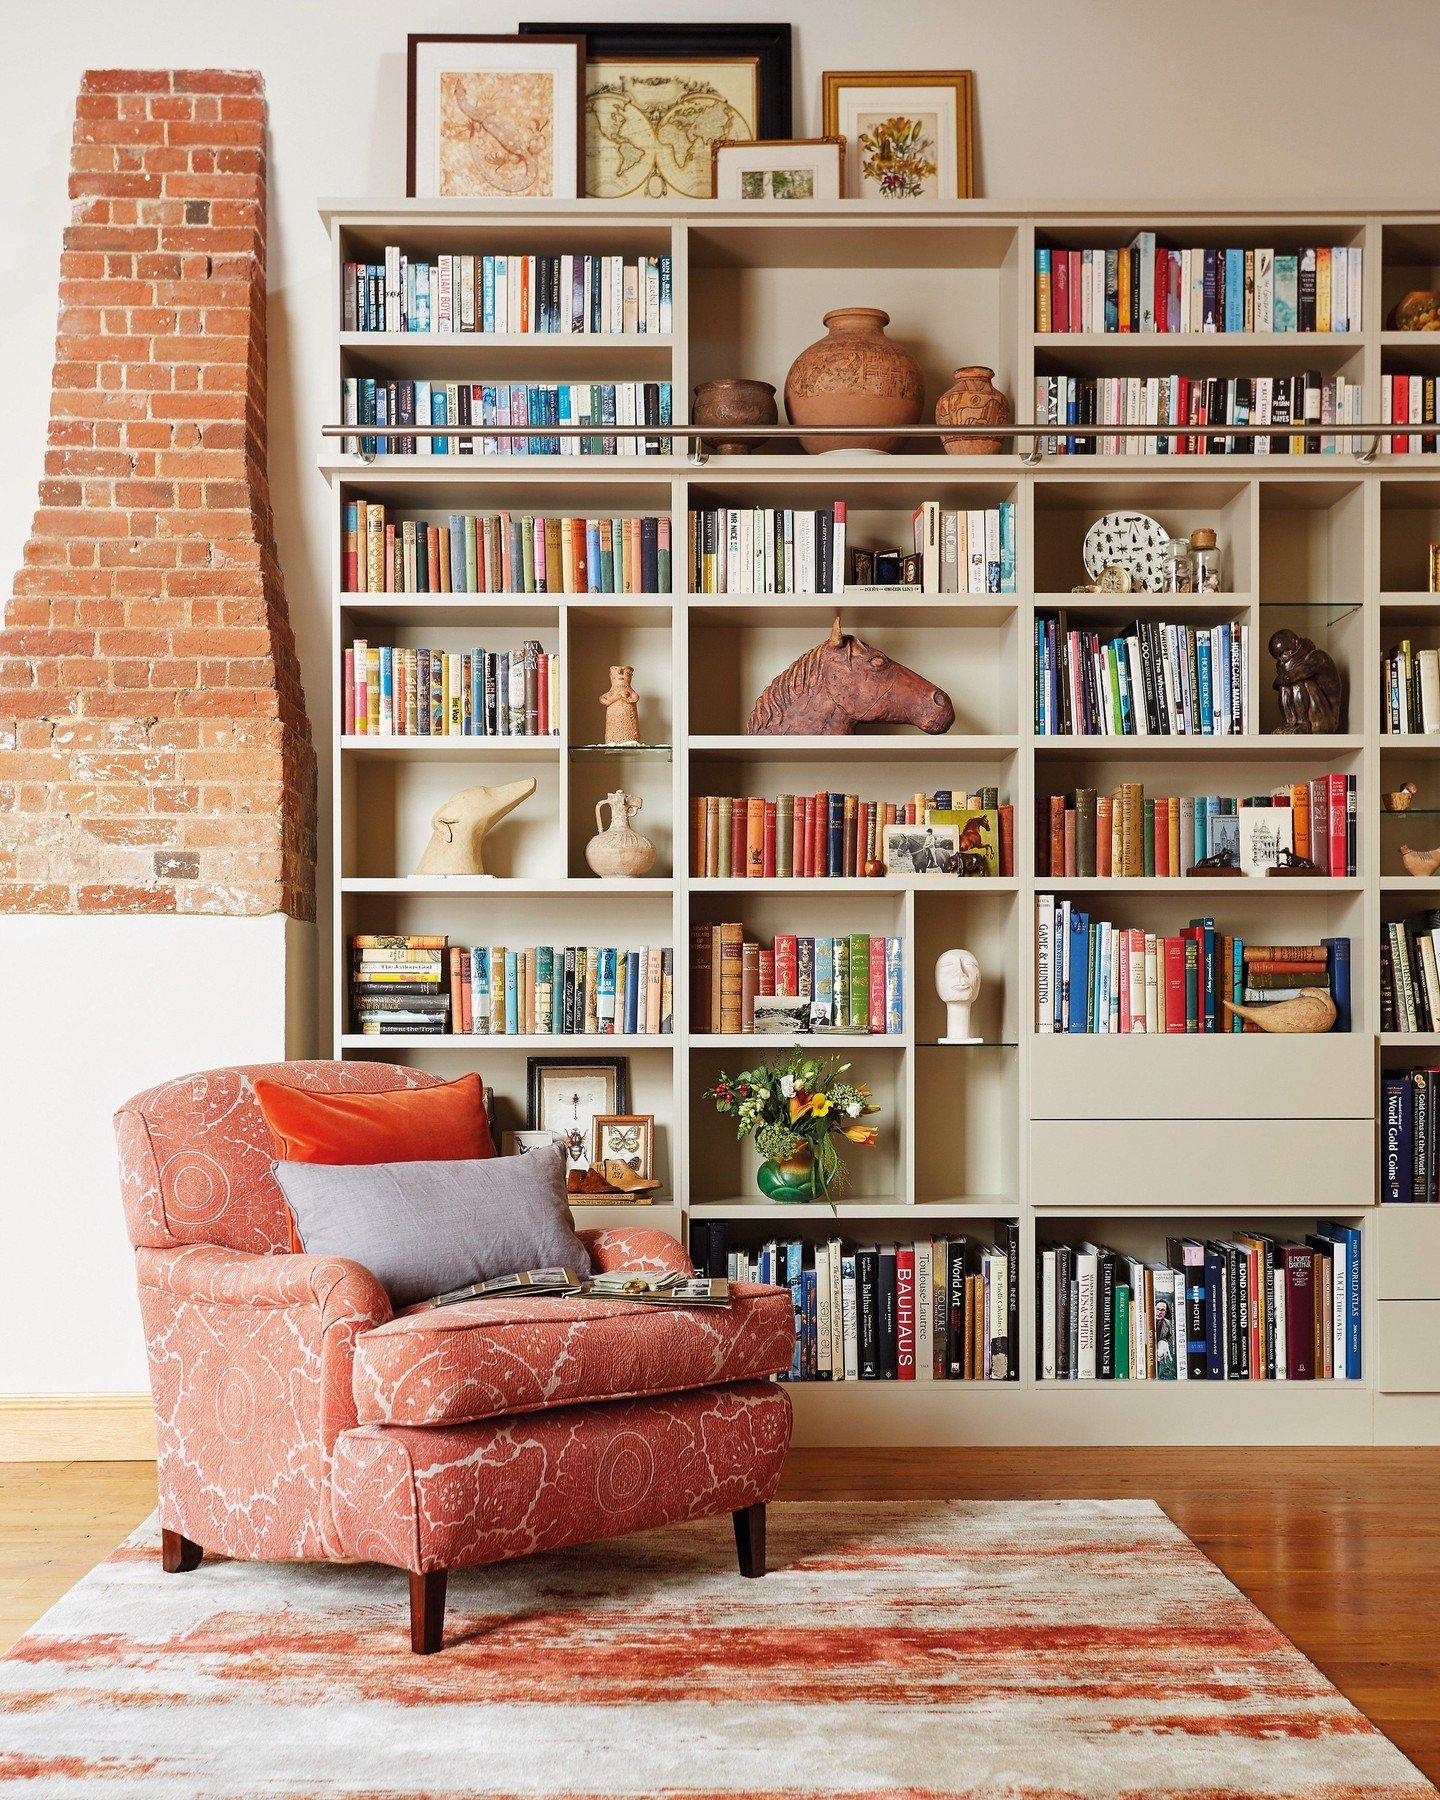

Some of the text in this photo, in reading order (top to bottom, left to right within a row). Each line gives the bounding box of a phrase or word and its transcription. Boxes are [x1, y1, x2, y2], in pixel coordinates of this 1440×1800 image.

[441, 259, 450, 293] WILLIAM
[648, 277, 657, 306] Jezebel
[731, 513, 737, 523] MR
[1157, 675, 1165, 709] Whippet
[1039, 924, 1048, 949] GAME
[1391, 941, 1400, 969] HENRY
[1039, 963, 1048, 1004] HUNTING
[1403, 965, 1411, 991] HENRY
[1389, 1096, 1398, 1180] World Gold Coins
[952, 1258, 962, 1287] World
[1336, 1272, 1344, 1299] VOGUE
[863, 1284, 871, 1313] Balthus
[919, 1254, 930, 1339] Toulouse-Lautrec
[952, 1290, 961, 1306] Art
[1081, 1274, 1089, 1306] WINES
[1240, 1290, 1246, 1301] ON
[818, 1301, 828, 1336] sixties
[897, 1268, 913, 1366] BAUHAUS
[937, 1290, 945, 1331] LOUVRE
[1102, 1270, 1111, 1365] GREAT BORDEAUX WINES
[1231, 1310, 1236, 1320] OF
[1081, 1315, 1089, 1350] SPIRITS
